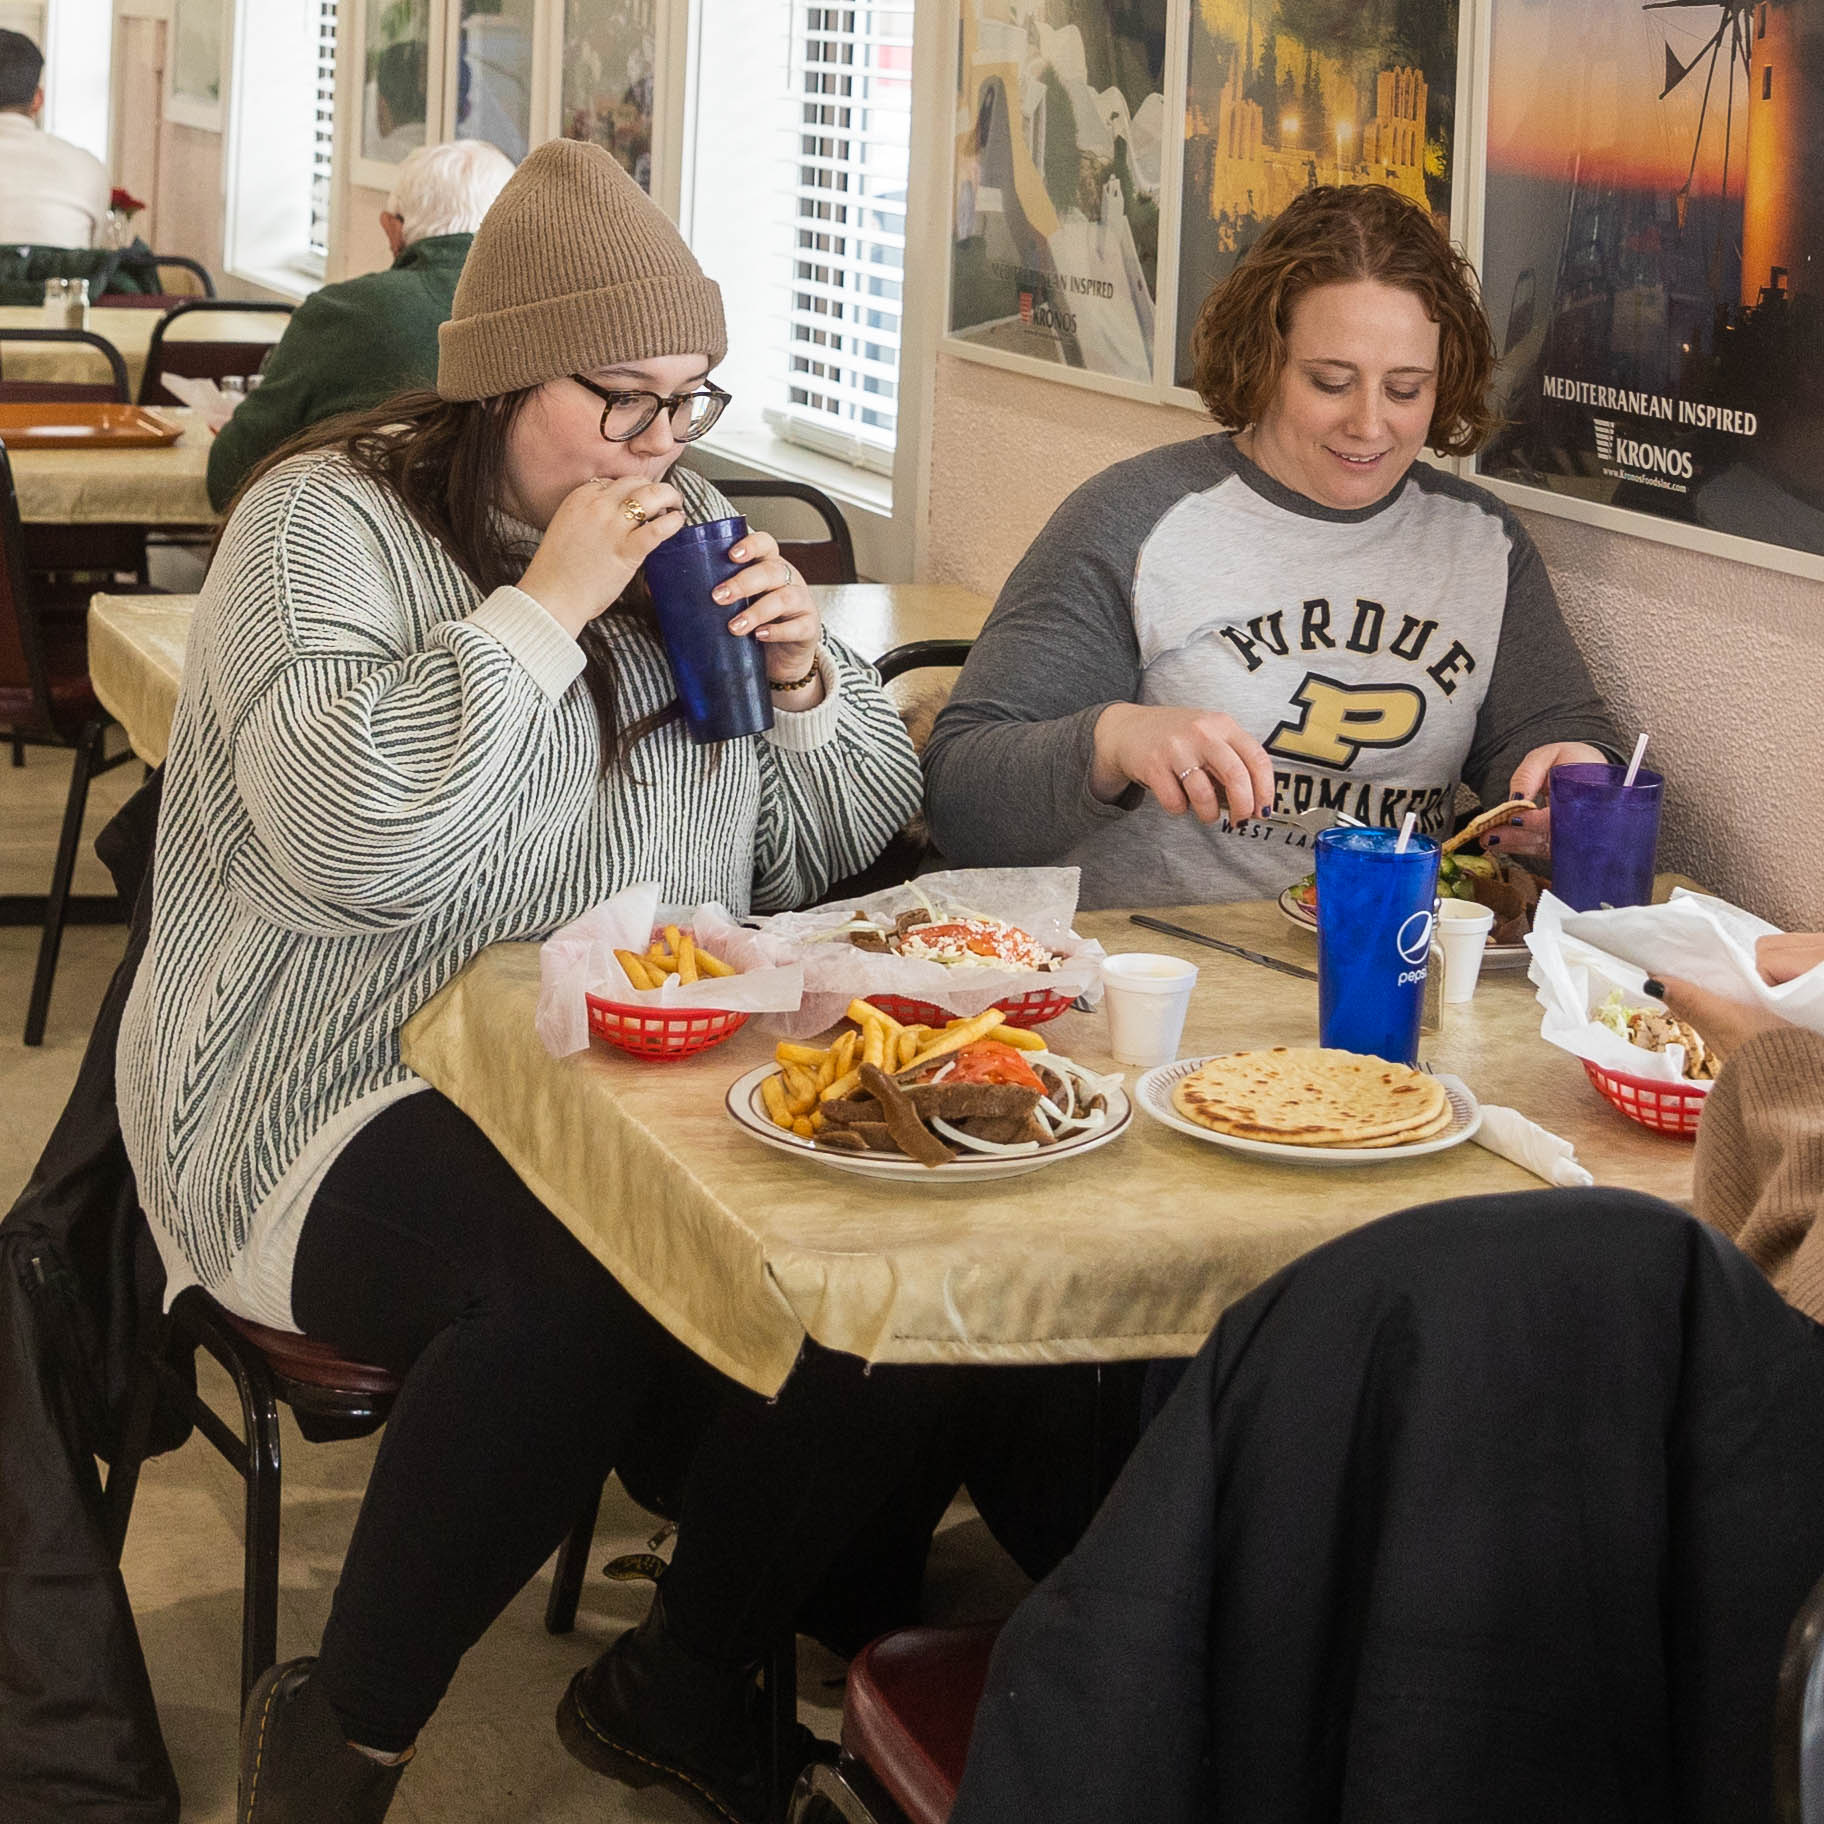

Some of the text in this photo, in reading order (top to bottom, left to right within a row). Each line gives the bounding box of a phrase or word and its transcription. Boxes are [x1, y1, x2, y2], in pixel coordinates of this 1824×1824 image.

[1070, 275, 1114, 299] INSPIRED
[1033, 307, 1077, 333] KRONOS
[1543, 375, 1757, 436] MEDITERRANEAN INSPIRED
[1616, 438, 1693, 478] KRONOS
[1219, 597, 1476, 696] PURDUE
[1261, 671, 1427, 772] P
[1222, 818, 1274, 841] WEST
